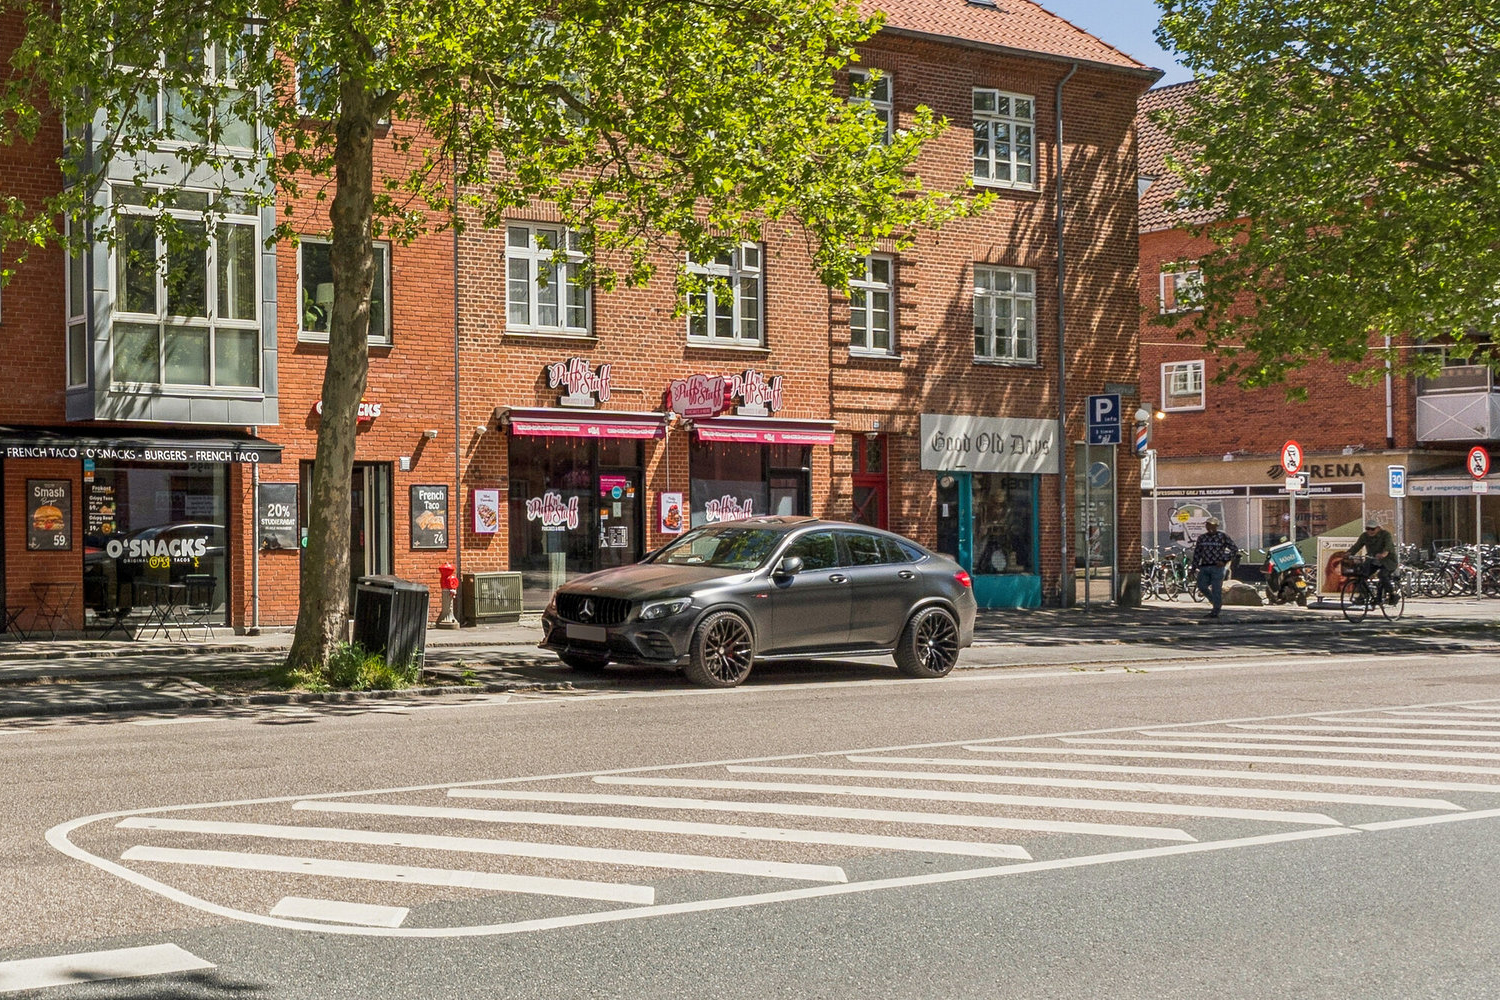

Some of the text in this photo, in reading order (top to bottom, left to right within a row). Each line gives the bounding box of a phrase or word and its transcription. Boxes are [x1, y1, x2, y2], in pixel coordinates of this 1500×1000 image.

[581, 364, 612, 402] Stuff
[674, 378, 700, 405] Puff
[700, 379, 723, 407] Stuff
[755, 376, 783, 412] Stuff
[1096, 399, 1113, 422] P
[7, 447, 47, 458] FRENCH
[48, 448, 77, 459] TACO
[86, 448, 136, 460] O'SNACKS
[145, 450, 187, 461] BURGERS
[195, 451, 232, 462] FRENCH
[234, 451, 260, 463] TACO
[931, 431, 1050, 459] Good Old Days
[1392, 474, 1402, 485] 30
[34, 486, 65, 498] Smash
[419, 490, 444, 501] French
[267, 503, 291, 517] 20%
[424, 500, 440, 510] Taco
[553, 496, 579, 530] Stuff
[106, 538, 207, 558] O'SNACKS
